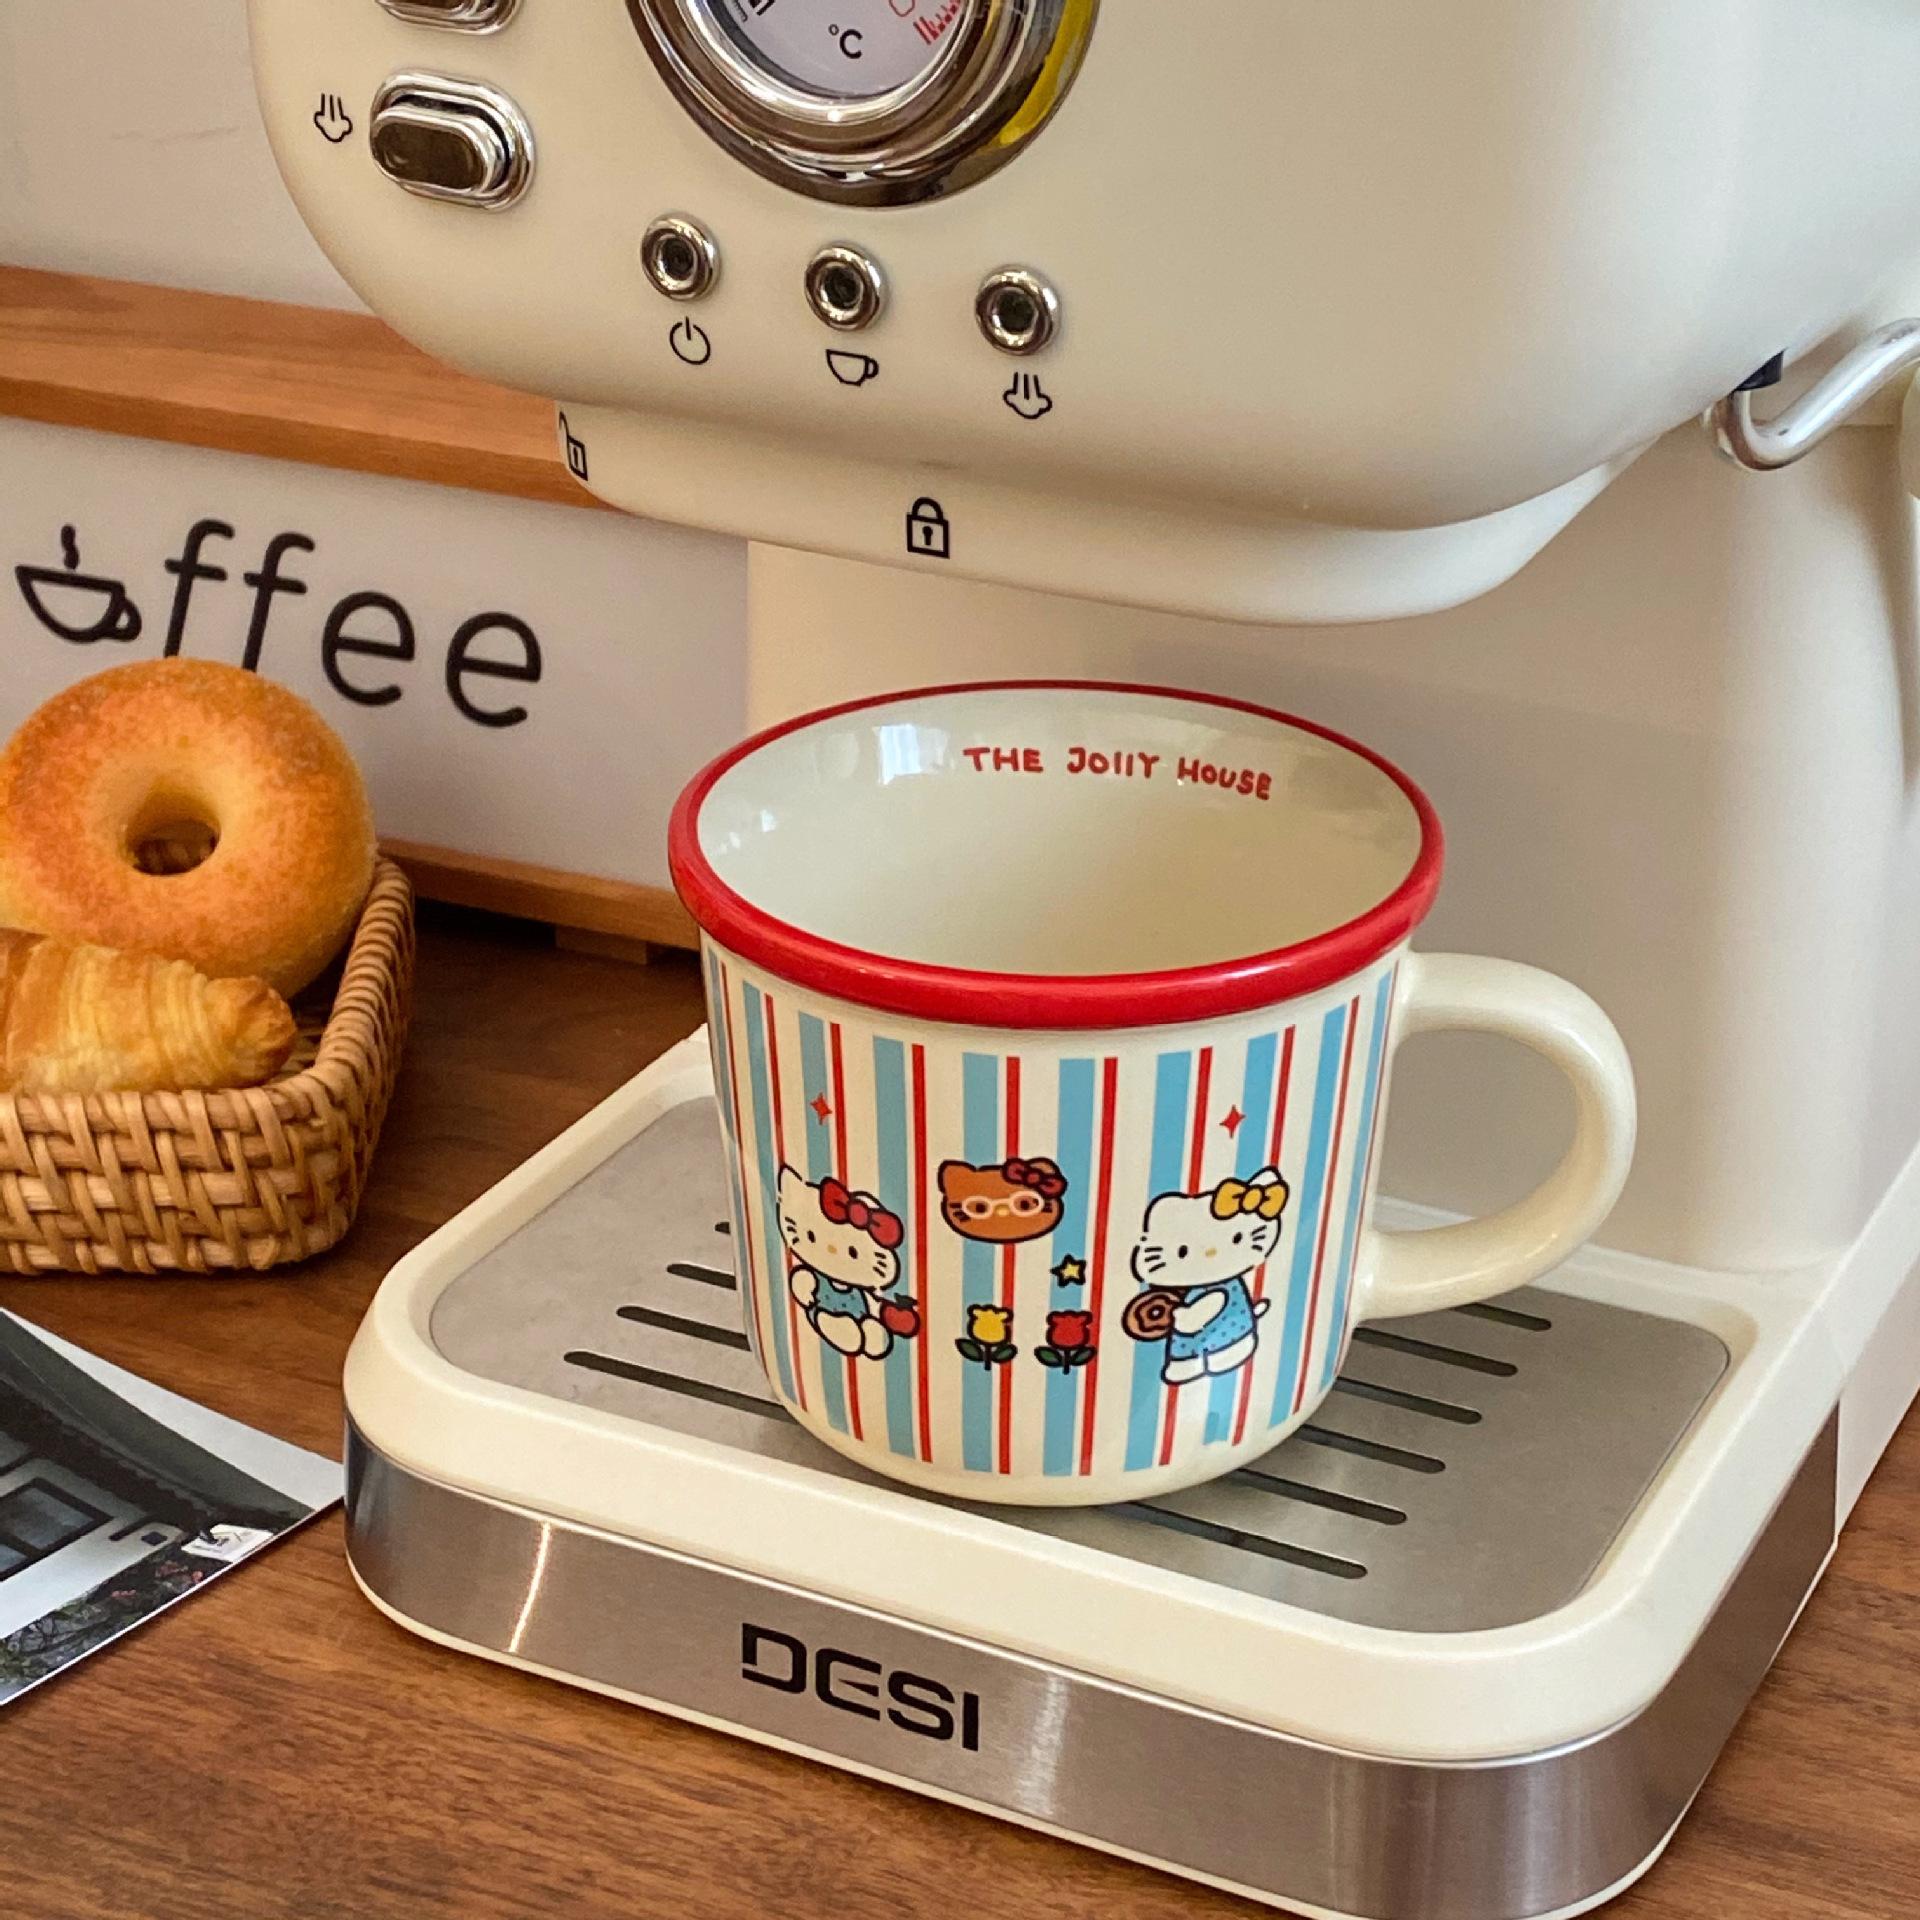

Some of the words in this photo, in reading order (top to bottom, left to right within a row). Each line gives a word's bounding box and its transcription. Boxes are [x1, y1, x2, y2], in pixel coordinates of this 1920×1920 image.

[963, 747, 1044, 772] THE
[1177, 757, 1272, 800] HOUSE
[742, 1622, 979, 1752] DESI
